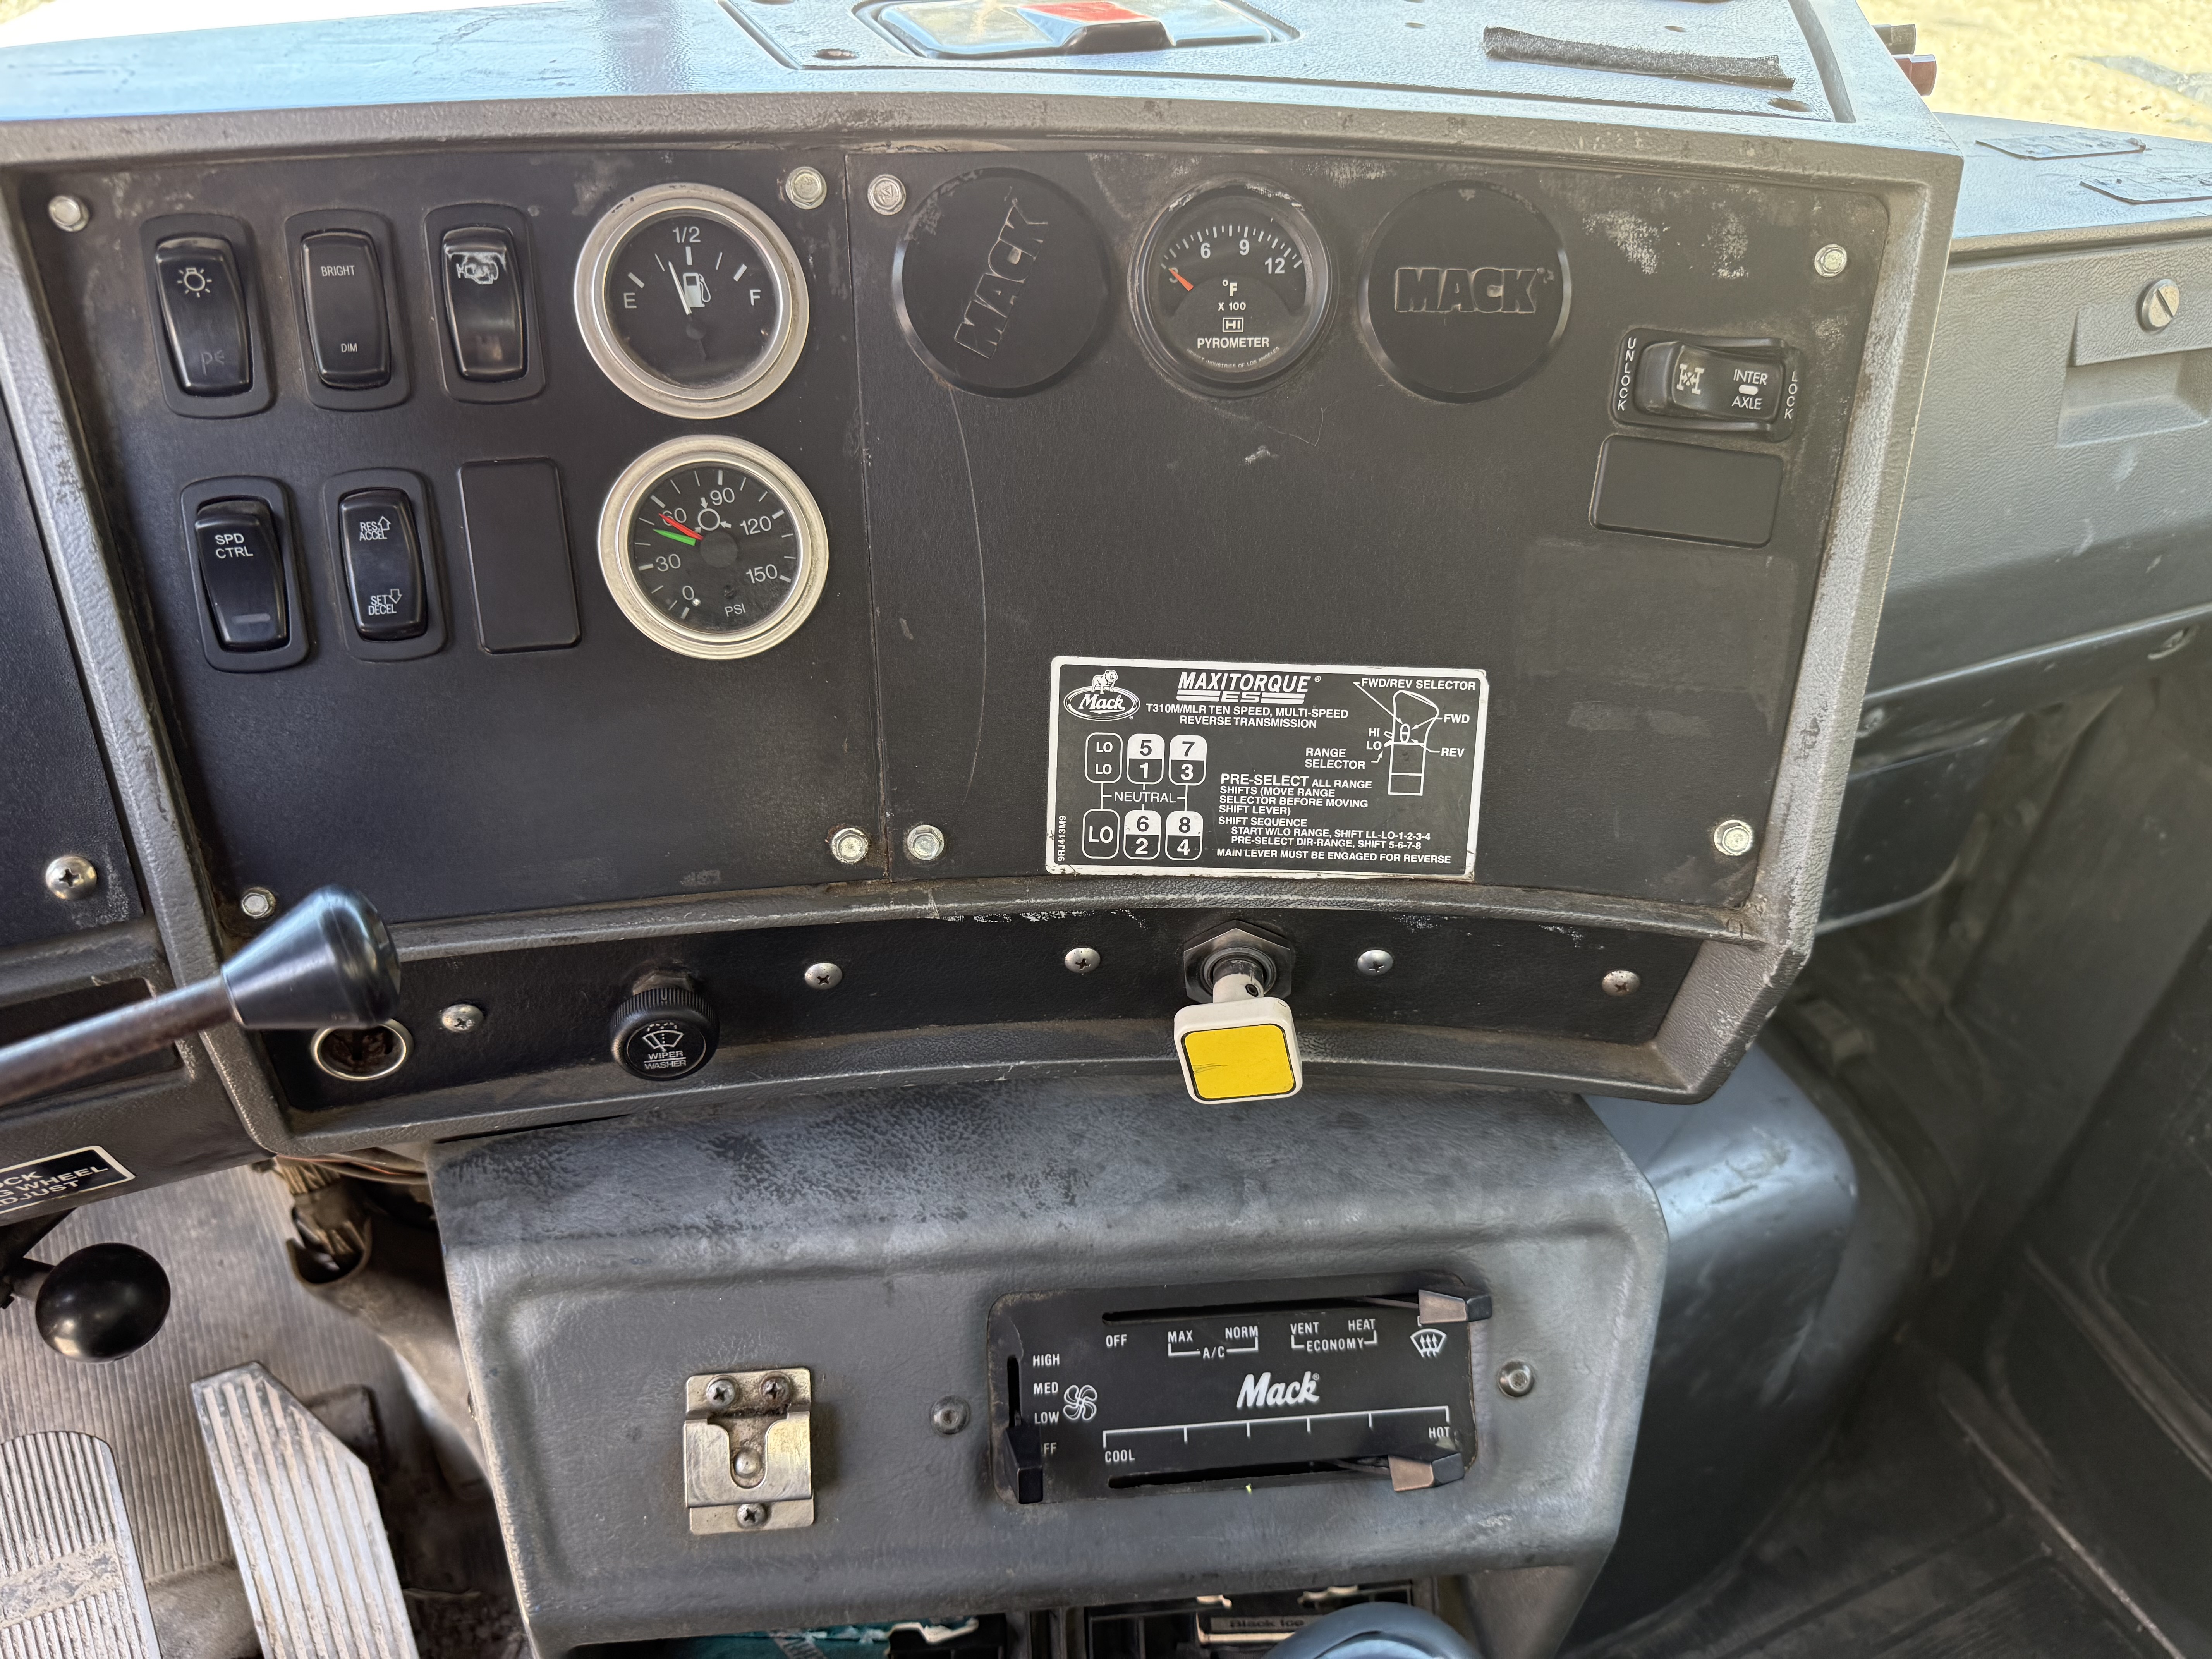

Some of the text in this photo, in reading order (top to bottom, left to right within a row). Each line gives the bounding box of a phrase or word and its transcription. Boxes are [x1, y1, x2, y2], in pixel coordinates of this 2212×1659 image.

[673, 227, 701, 243] 1/2
[1200, 242, 1211, 259] 6
[1239, 239, 1249, 256] 9
[321, 265, 355, 276] BRIGHT
[1264, 258, 1285, 275] 12
[1169, 267, 1178, 283] 3
[955, 205, 1048, 359] MACK
[1395, 267, 1537, 314] MACK
[623, 293, 636, 308] E
[750, 289, 761, 306] F
[1218, 302, 1246, 311] X 100
[1225, 320, 1240, 329] HI
[341, 343, 357, 352] DIM
[1197, 337, 1269, 349] PYROMETER
[1617, 338, 1637, 411] UNLOCK
[1733, 369, 1767, 385] INTER
[1784, 371, 1798, 419] LOCK
[1731, 397, 1762, 410] AXLE
[710, 487, 735, 506] 90
[662, 508, 687, 526] 60
[740, 516, 772, 536] 120
[215, 533, 244, 545] SPD
[359, 530, 388, 541] ACCEL
[216, 546, 254, 559] CTRL
[656, 553, 681, 572] 30
[746, 564, 778, 584] 150
[682, 585, 695, 601] 0
[371, 595, 388, 606] SET
[368, 604, 397, 616] DECEL
[724, 603, 746, 617] PSI
[1178, 672, 1311, 693] MAXITORQUE
[1361, 678, 1476, 691] FWD/REV SELECTOR
[1221, 691, 1261, 703] ES
[1078, 694, 1126, 714] Mack
[1146, 703, 1349, 719] T310M/MLR TEN SPEED, MULTI-SPEED
[1180, 716, 1317, 728] REVERSE TRANSMISSION
[1444, 714, 1470, 724] FWD
[1369, 728, 1380, 737] HI
[1096, 742, 1113, 753] LO
[1140, 740, 1152, 756] 5
[1182, 741, 1195, 757] 7
[1366, 741, 1382, 750] LO
[1441, 747, 1465, 757] REV
[1305, 747, 1346, 758] RANGE
[1095, 764, 1112, 775] LO
[1140, 762, 1149, 779] 1
[1305, 759, 1365, 769] SELECTOR
[1180, 764, 1193, 780] 3
[1221, 773, 1372, 789] PRE-SELECT ALL RANGE
[1115, 791, 1176, 803] NEUTRAL
[1220, 786, 1335, 797] SHIFTS (MOVE RANGE
[1219, 795, 1368, 808] SELECTOR BEFORE MOVING
[1219, 805, 1291, 816] SHIFT LEVER)
[1137, 816, 1149, 832] 6
[1178, 817, 1190, 833] 8
[1218, 816, 1307, 827] SHIFT SEQUENCE
[1058, 815, 1066, 862] 9RJ413M9
[1089, 826, 1113, 843] LO
[1231, 826, 1431, 841] START W/LO RANGE, SHIFT LL-LO-1-2-3-4
[1135, 838, 1148, 854] 2
[1177, 839, 1190, 855] 4
[1231, 836, 1421, 850] PRE-SELECT DIR-RANGE, SHIFT 5-6-7-8
[1217, 848, 1451, 864] MAIN LEVER MUST BE ENGAGED FOR REVERSE
[648, 1050, 683, 1060] WIPER
[644, 1060, 686, 1070] WASHER
[15, 1166, 108, 1191] WHEEL
[1290, 1322, 1319, 1335] VENT
[1348, 1319, 1376, 1331] HEAT
[1168, 1330, 1193, 1343] MAX
[1225, 1326, 1259, 1339] NORM
[1106, 1334, 1127, 1347] OFF
[1306, 1338, 1364, 1352] ECONOMY
[1203, 1346, 1225, 1359] A/C
[1033, 1354, 1060, 1367] HIGH
[1034, 1381, 1059, 1395] MED
[1237, 1371, 1320, 1408] Mack
[1034, 1411, 1059, 1424] LOW
[1429, 1427, 1450, 1439] HOT
[1041, 1442, 1057, 1455] FF
[1105, 1449, 1135, 1462] COOL
